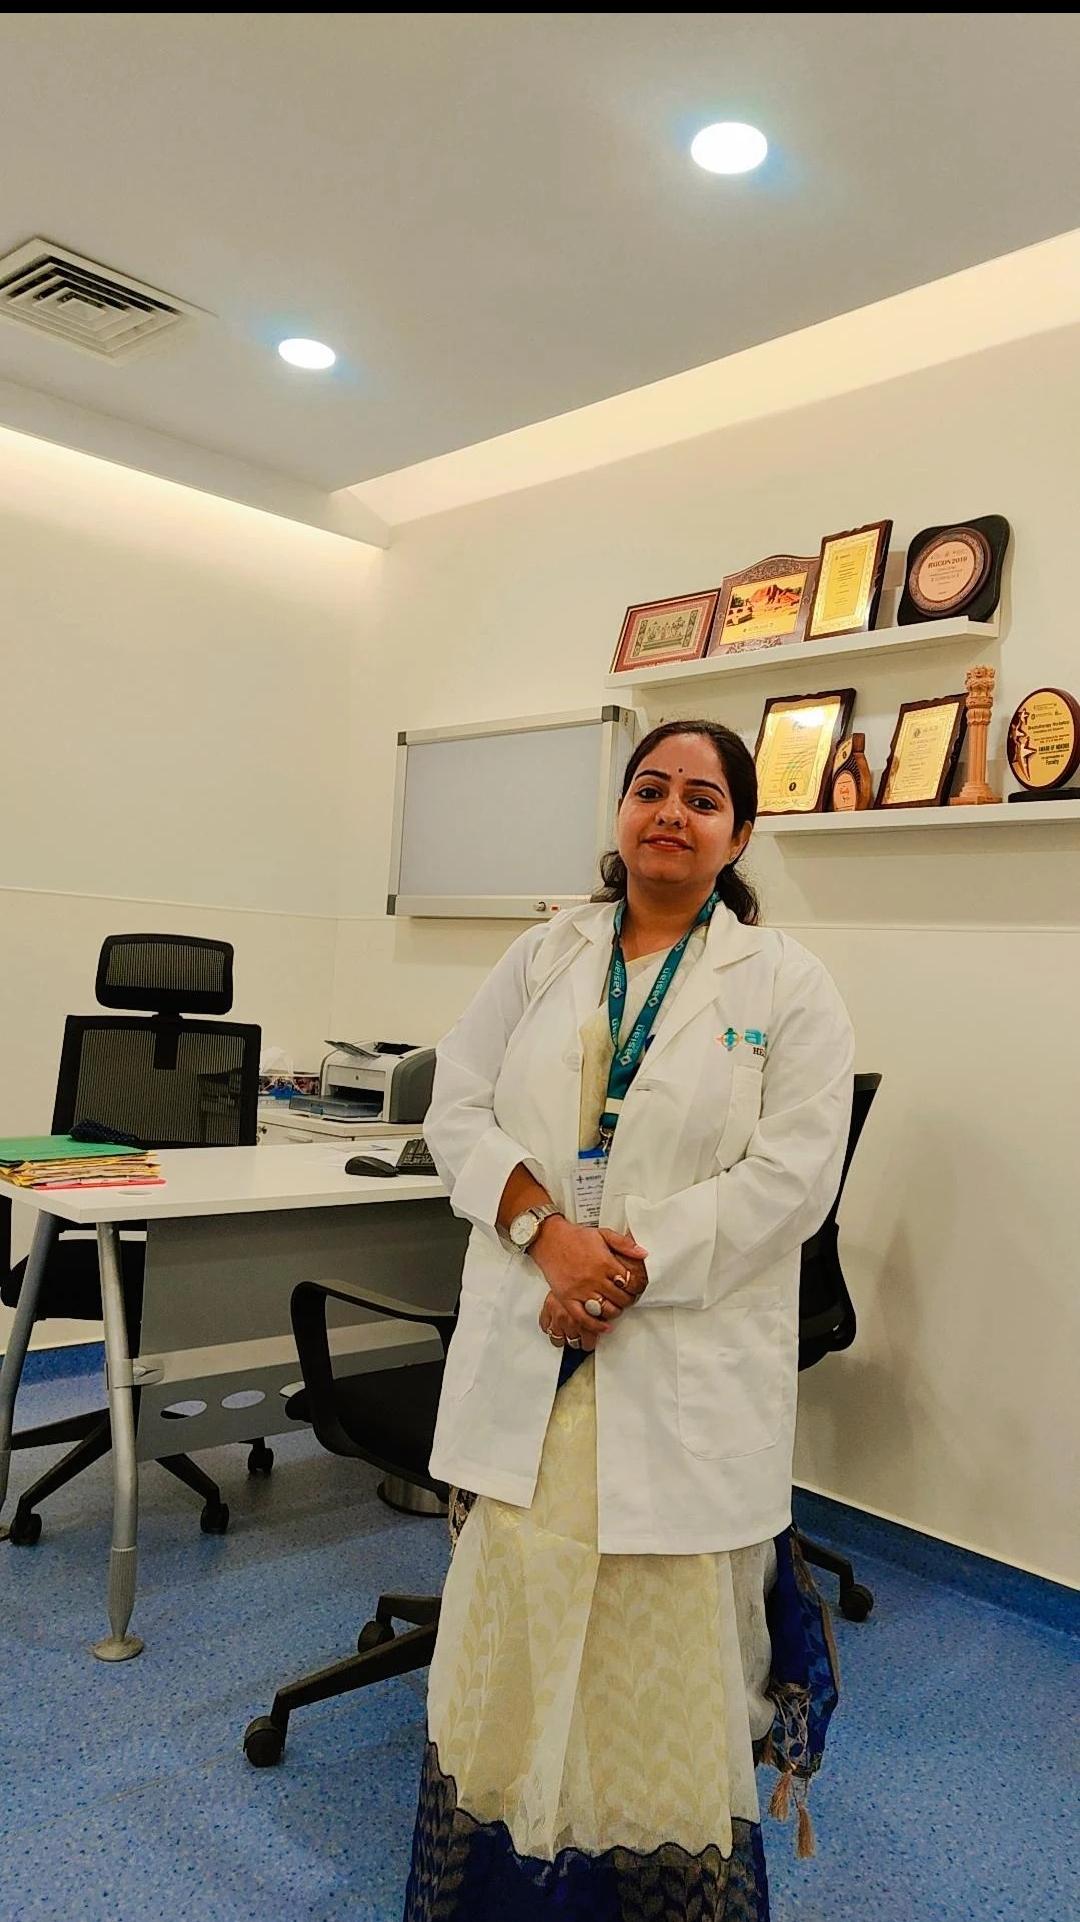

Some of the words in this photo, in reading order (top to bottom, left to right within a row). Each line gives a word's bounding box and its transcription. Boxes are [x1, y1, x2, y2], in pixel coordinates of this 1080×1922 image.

[614, 960, 622, 988] asian
[652, 966, 670, 998] asian
[623, 1023, 646, 1056] asian
